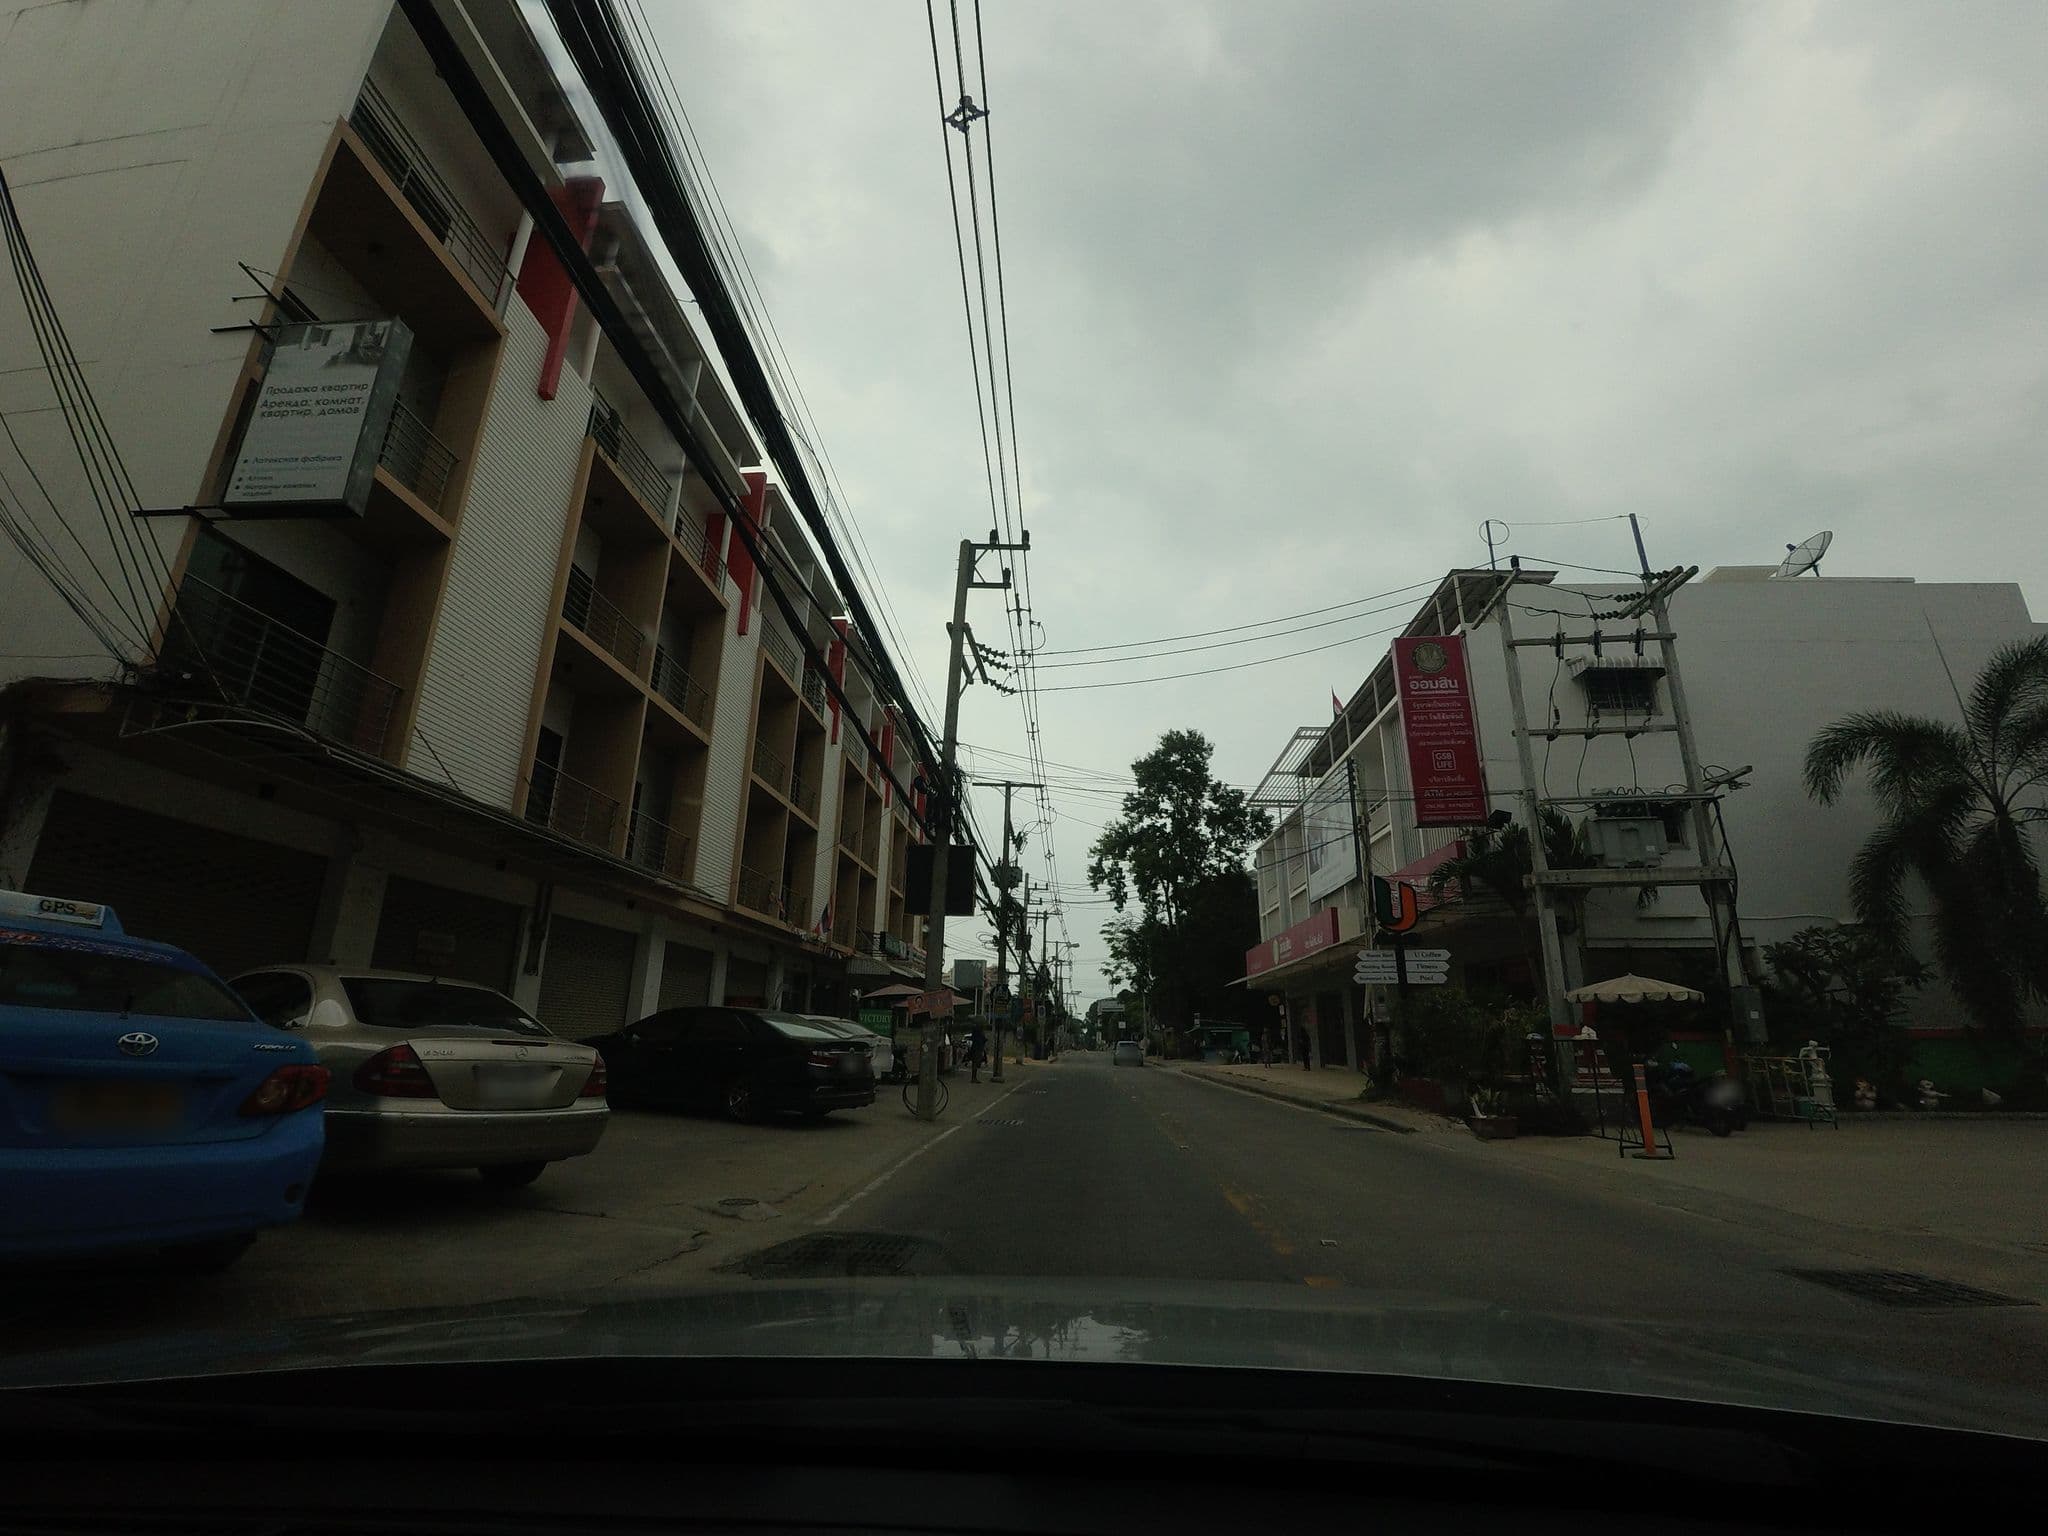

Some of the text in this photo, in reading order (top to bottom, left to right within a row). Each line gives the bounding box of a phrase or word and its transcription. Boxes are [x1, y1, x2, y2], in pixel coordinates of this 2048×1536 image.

[266, 383, 369, 395] Продажа квартир
[260, 399, 312, 409] Аренда:
[318, 407, 359, 416] домов
[1409, 676, 1459, 690] ออมสิน
[1434, 752, 1452, 760] GSB
[1436, 760, 1454, 769] LIFE
[39, 899, 76, 914] GPS
[860, 1014, 892, 1023] VICTORY
